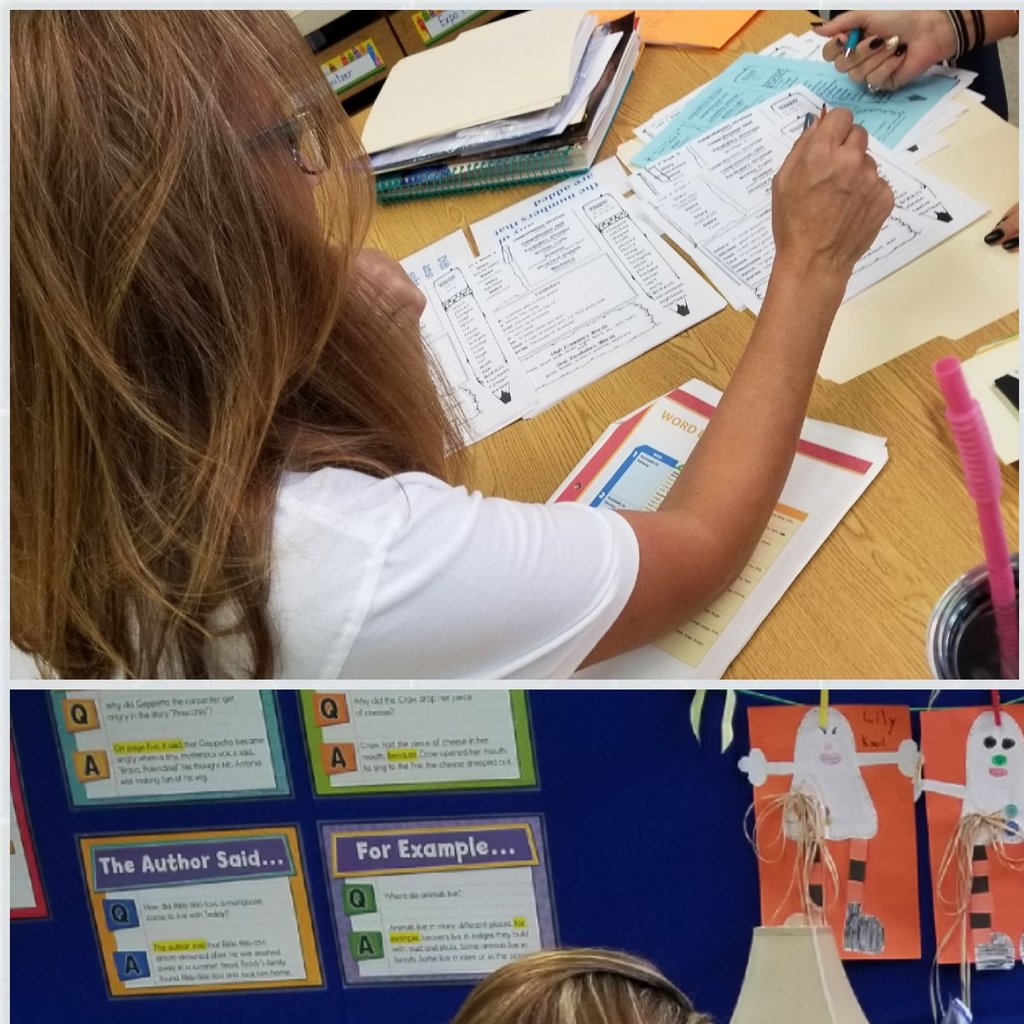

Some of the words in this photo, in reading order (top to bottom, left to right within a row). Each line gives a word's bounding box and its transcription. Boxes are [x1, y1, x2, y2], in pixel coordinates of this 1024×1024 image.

[330, 70, 353, 86] nitzer
[662, 410, 697, 433] WORD
[71, 703, 88, 725] Q
[320, 698, 338, 719] Q
[863, 709, 896, 735] Lily
[85, 754, 100, 776] A
[331, 747, 346, 767] A
[356, 841, 391, 860] For
[397, 836, 515, 863] Example...
[98, 857, 135, 875] The
[141, 853, 210, 874] Author
[216, 850, 284, 869] Said...
[350, 889, 366, 908] Q
[111, 903, 128, 923] Q
[359, 935, 374, 955] A
[125, 954, 140, 975] A
